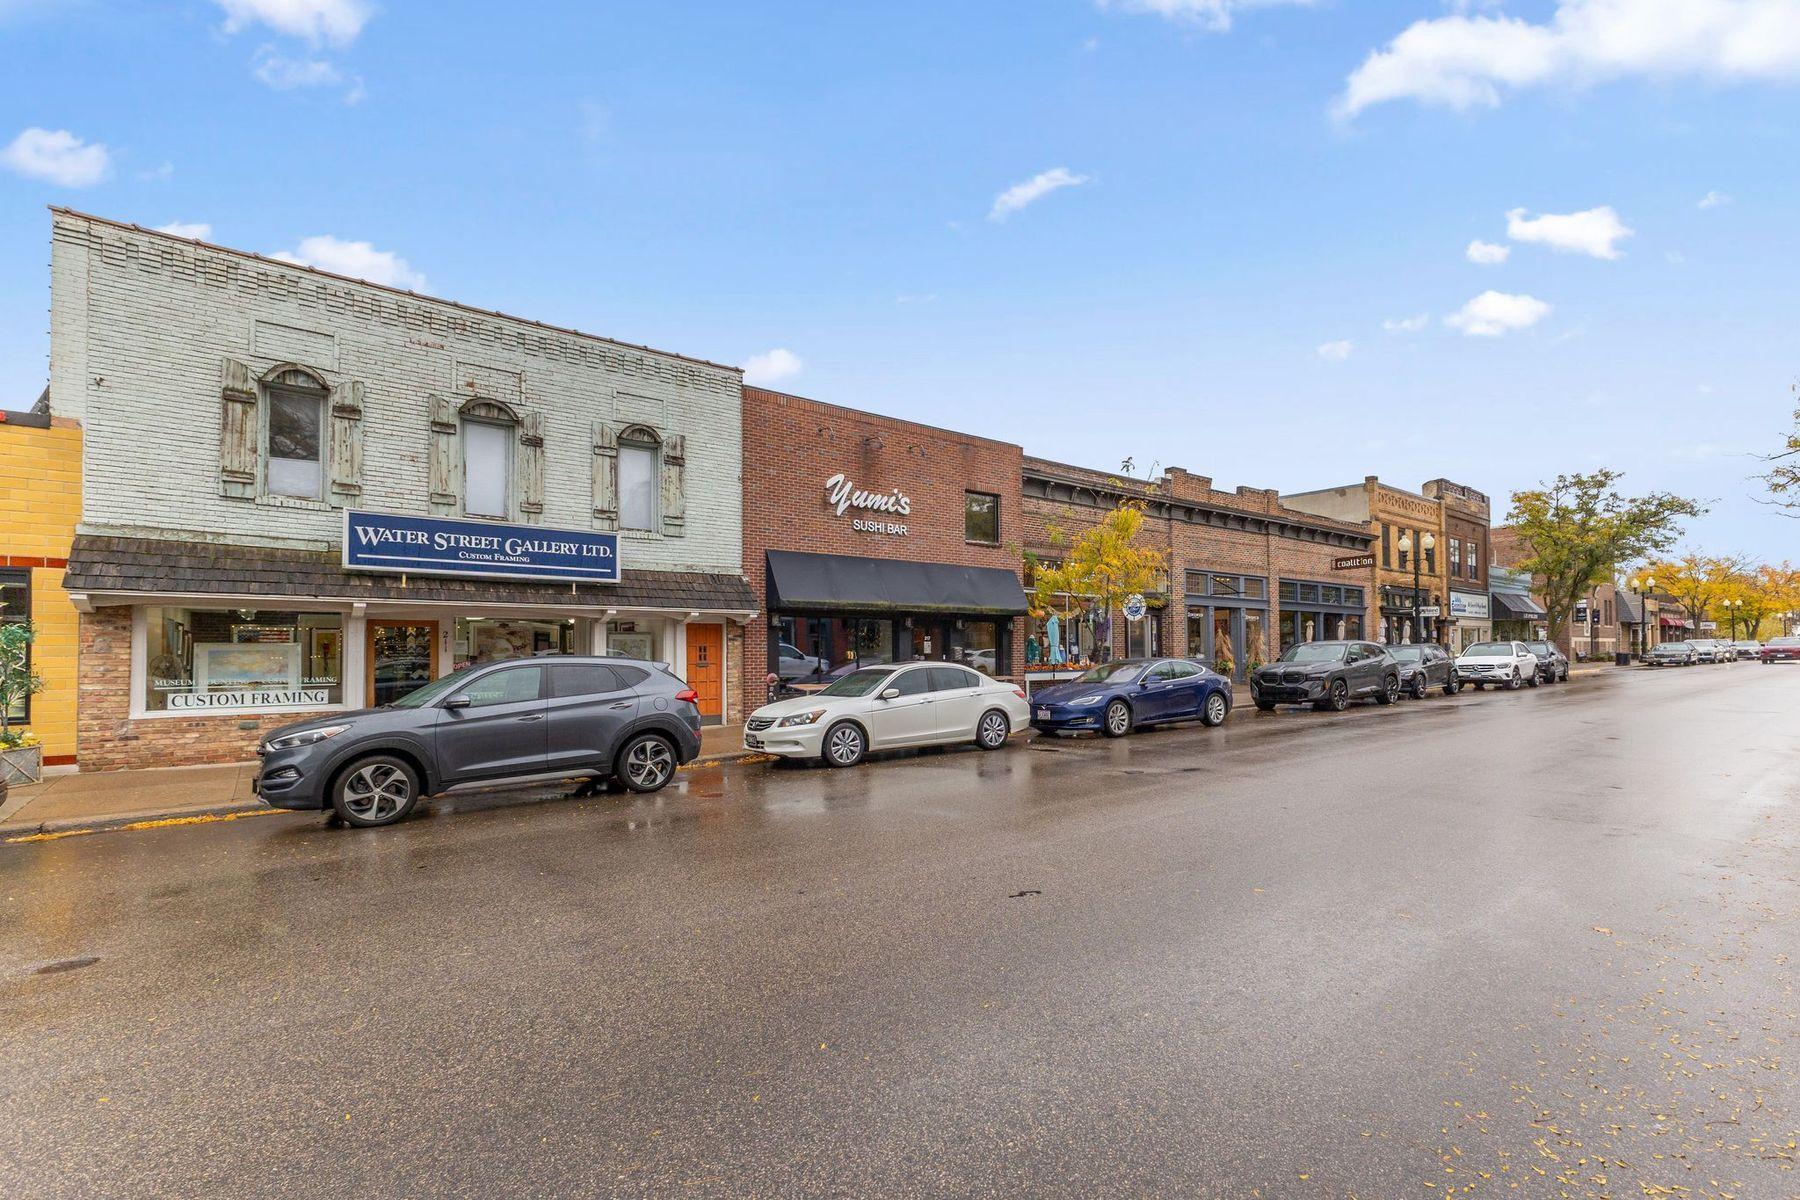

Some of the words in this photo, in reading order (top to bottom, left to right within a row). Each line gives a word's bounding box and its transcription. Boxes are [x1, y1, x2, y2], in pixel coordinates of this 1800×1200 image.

[826, 473, 911, 517] Yumi's
[853, 519, 885, 533] SUSHI
[887, 523, 908, 535] BAR
[354, 525, 430, 546] WATER
[434, 532, 502, 550] STREET
[505, 538, 579, 555] GALLERY
[582, 545, 613, 558] LTD.
[458, 550, 493, 561] CUSTOM
[494, 552, 530, 563] FRAMING
[1337, 557, 1373, 568] coalition
[171, 693, 245, 708] CUSTOM
[251, 690, 325, 705] FRAMING
